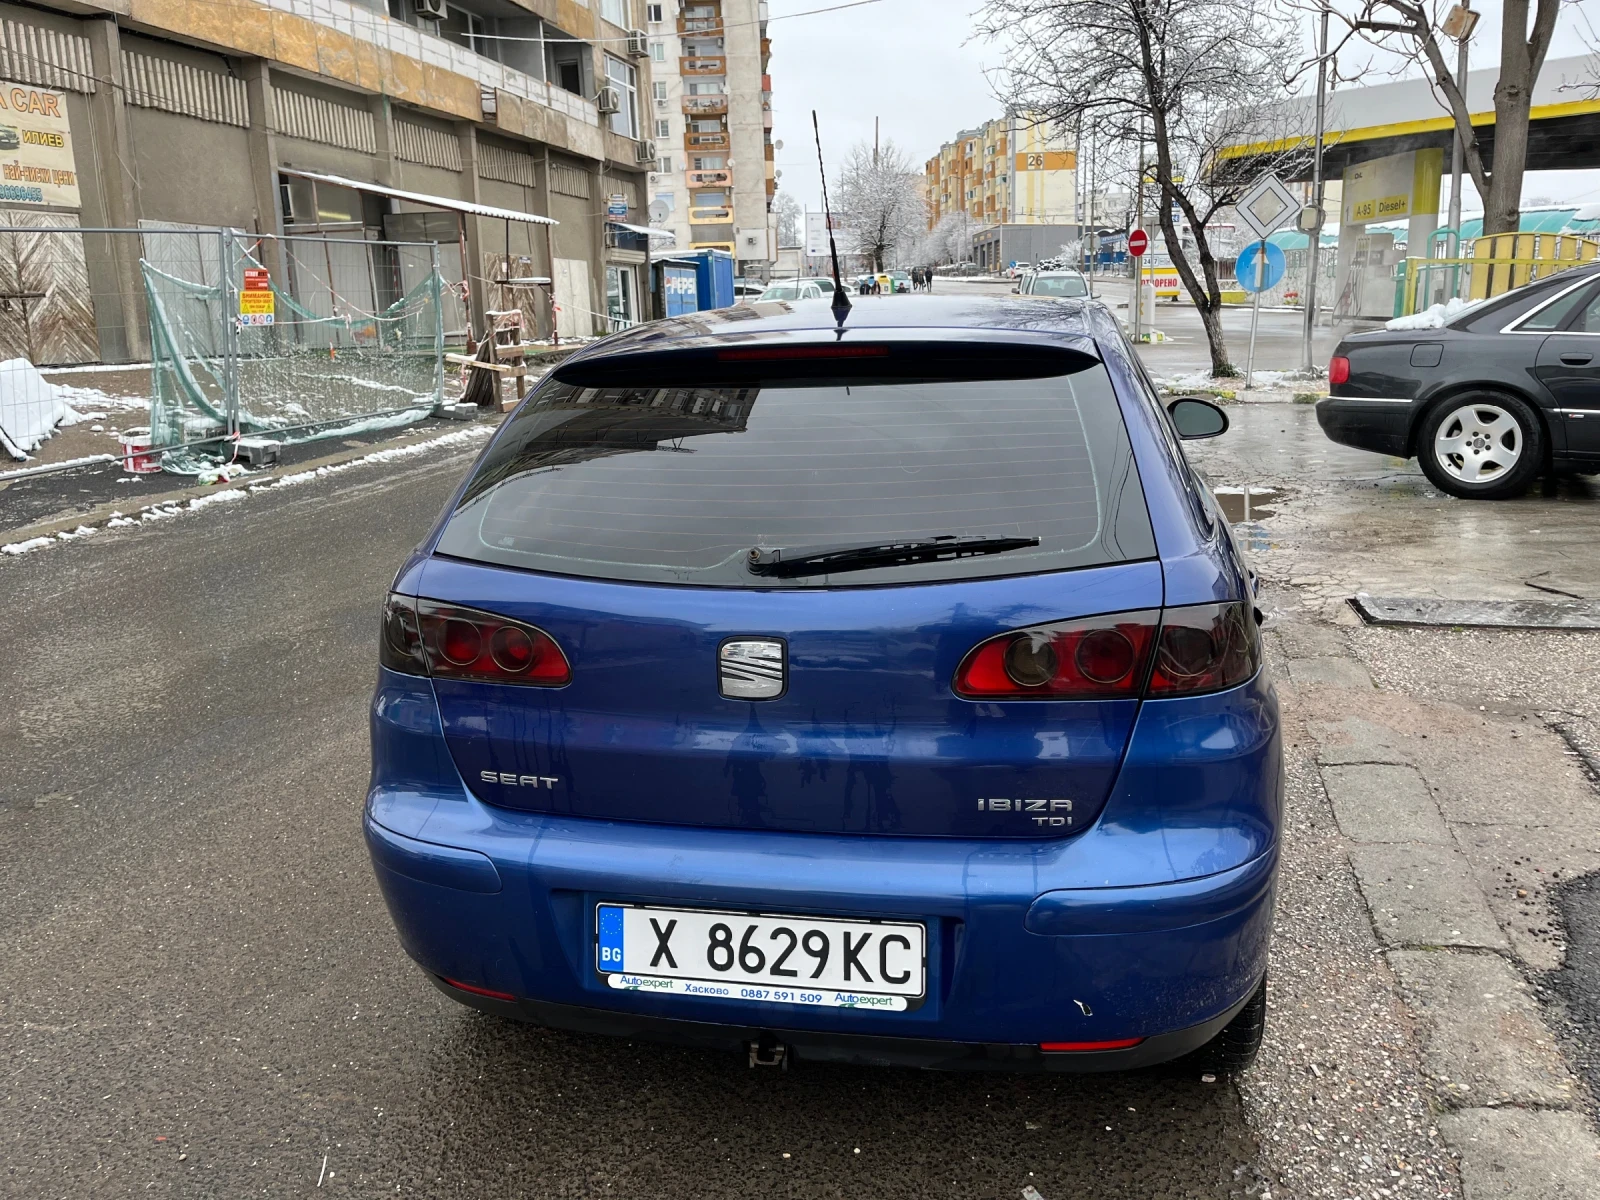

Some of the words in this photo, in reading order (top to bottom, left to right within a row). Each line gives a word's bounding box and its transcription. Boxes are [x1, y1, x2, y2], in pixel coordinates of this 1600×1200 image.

[10, 87, 61, 118] CAR
[22, 129, 64, 148] ИЛИЕВ
[1028, 155, 1043, 166] 26
[2, 159, 52, 184] най-ниски
[52, 169, 75, 188] цени
[1379, 200, 1406, 212] Diesel+
[480, 770, 558, 790] SEAT
[977, 798, 1073, 812] IBIZA
[1031, 816, 1073, 827] TDI
[601, 946, 622, 962] BG
[648, 917, 678, 969] X
[707, 922, 830, 979] 8629
[843, 931, 911, 985] KC
[620, 975, 673, 989] Autoexpert
[685, 983, 729, 996] Хасково
[741, 988, 769, 999] 0887
[773, 990, 795, 1001] 591
[799, 993, 822, 1003] 509
[834, 992, 893, 1007] Autoexpert
